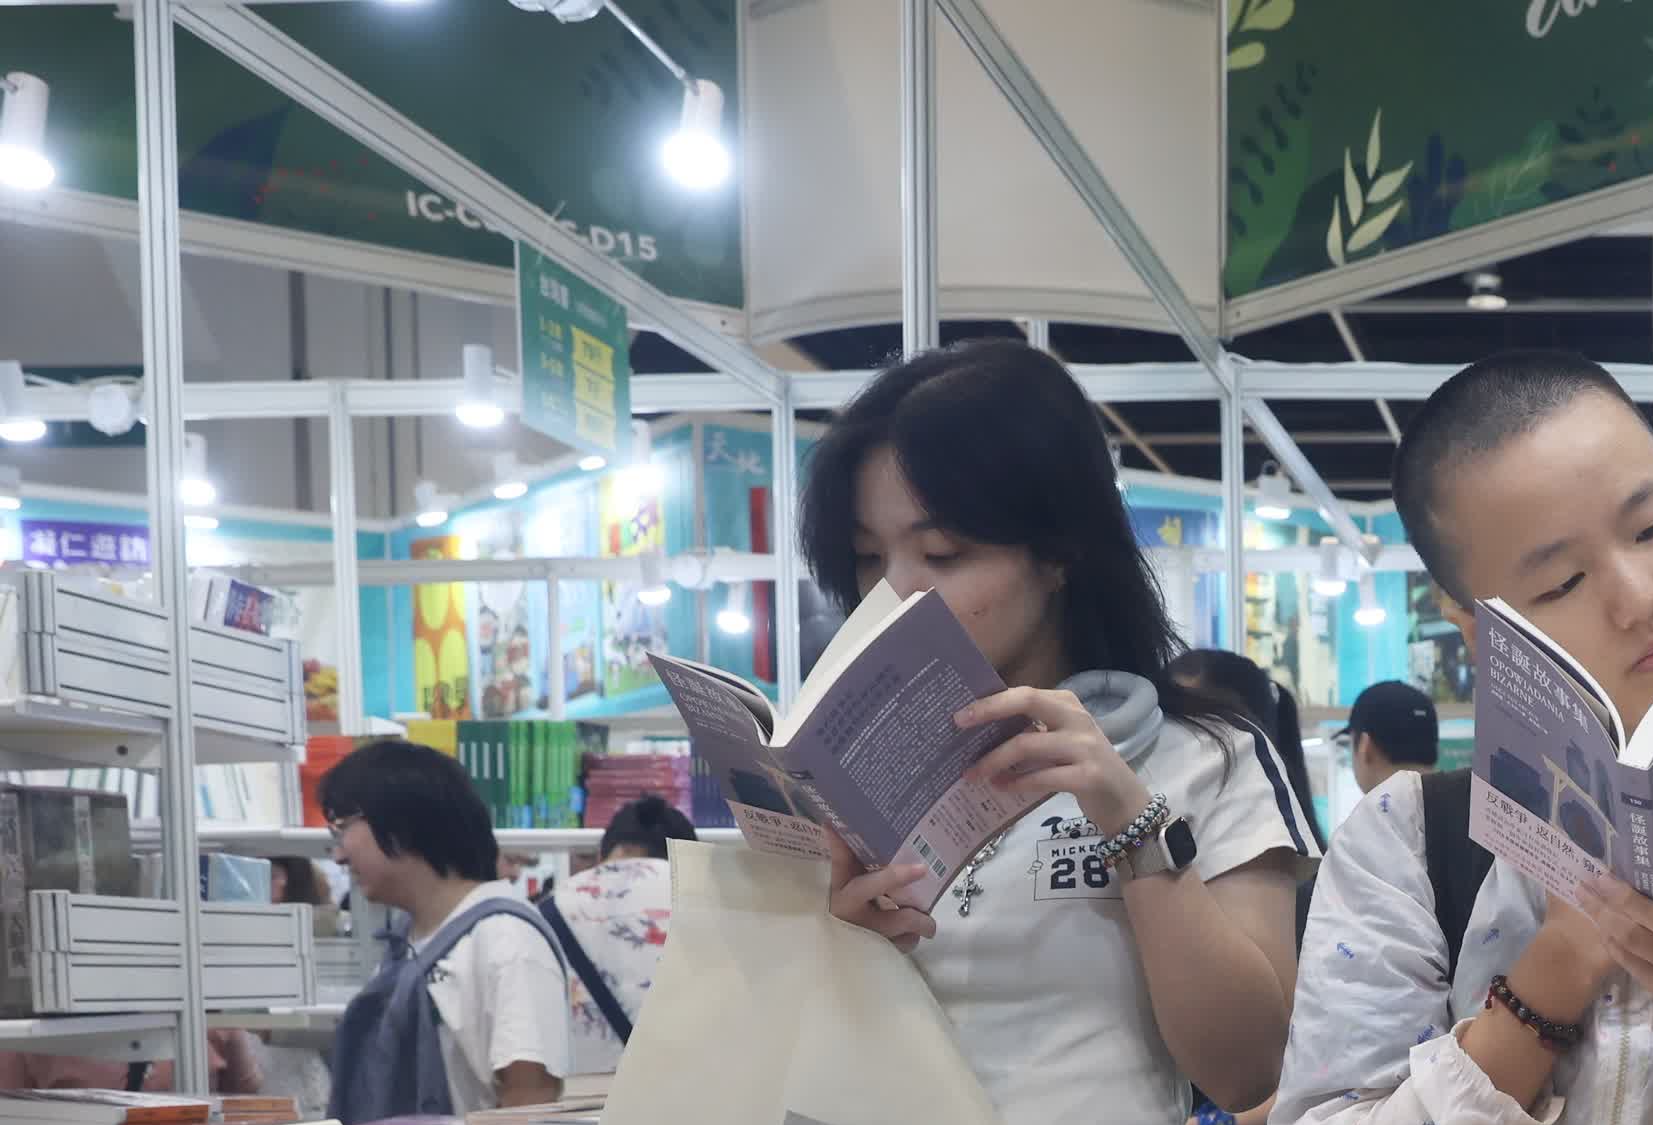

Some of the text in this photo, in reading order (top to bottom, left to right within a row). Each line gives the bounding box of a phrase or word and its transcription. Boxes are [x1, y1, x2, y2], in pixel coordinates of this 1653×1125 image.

[1488, 627, 1590, 736] 怪誕故事集
[1051, 844, 1096, 858] MICKE
[1050, 854, 1110, 890] 28
